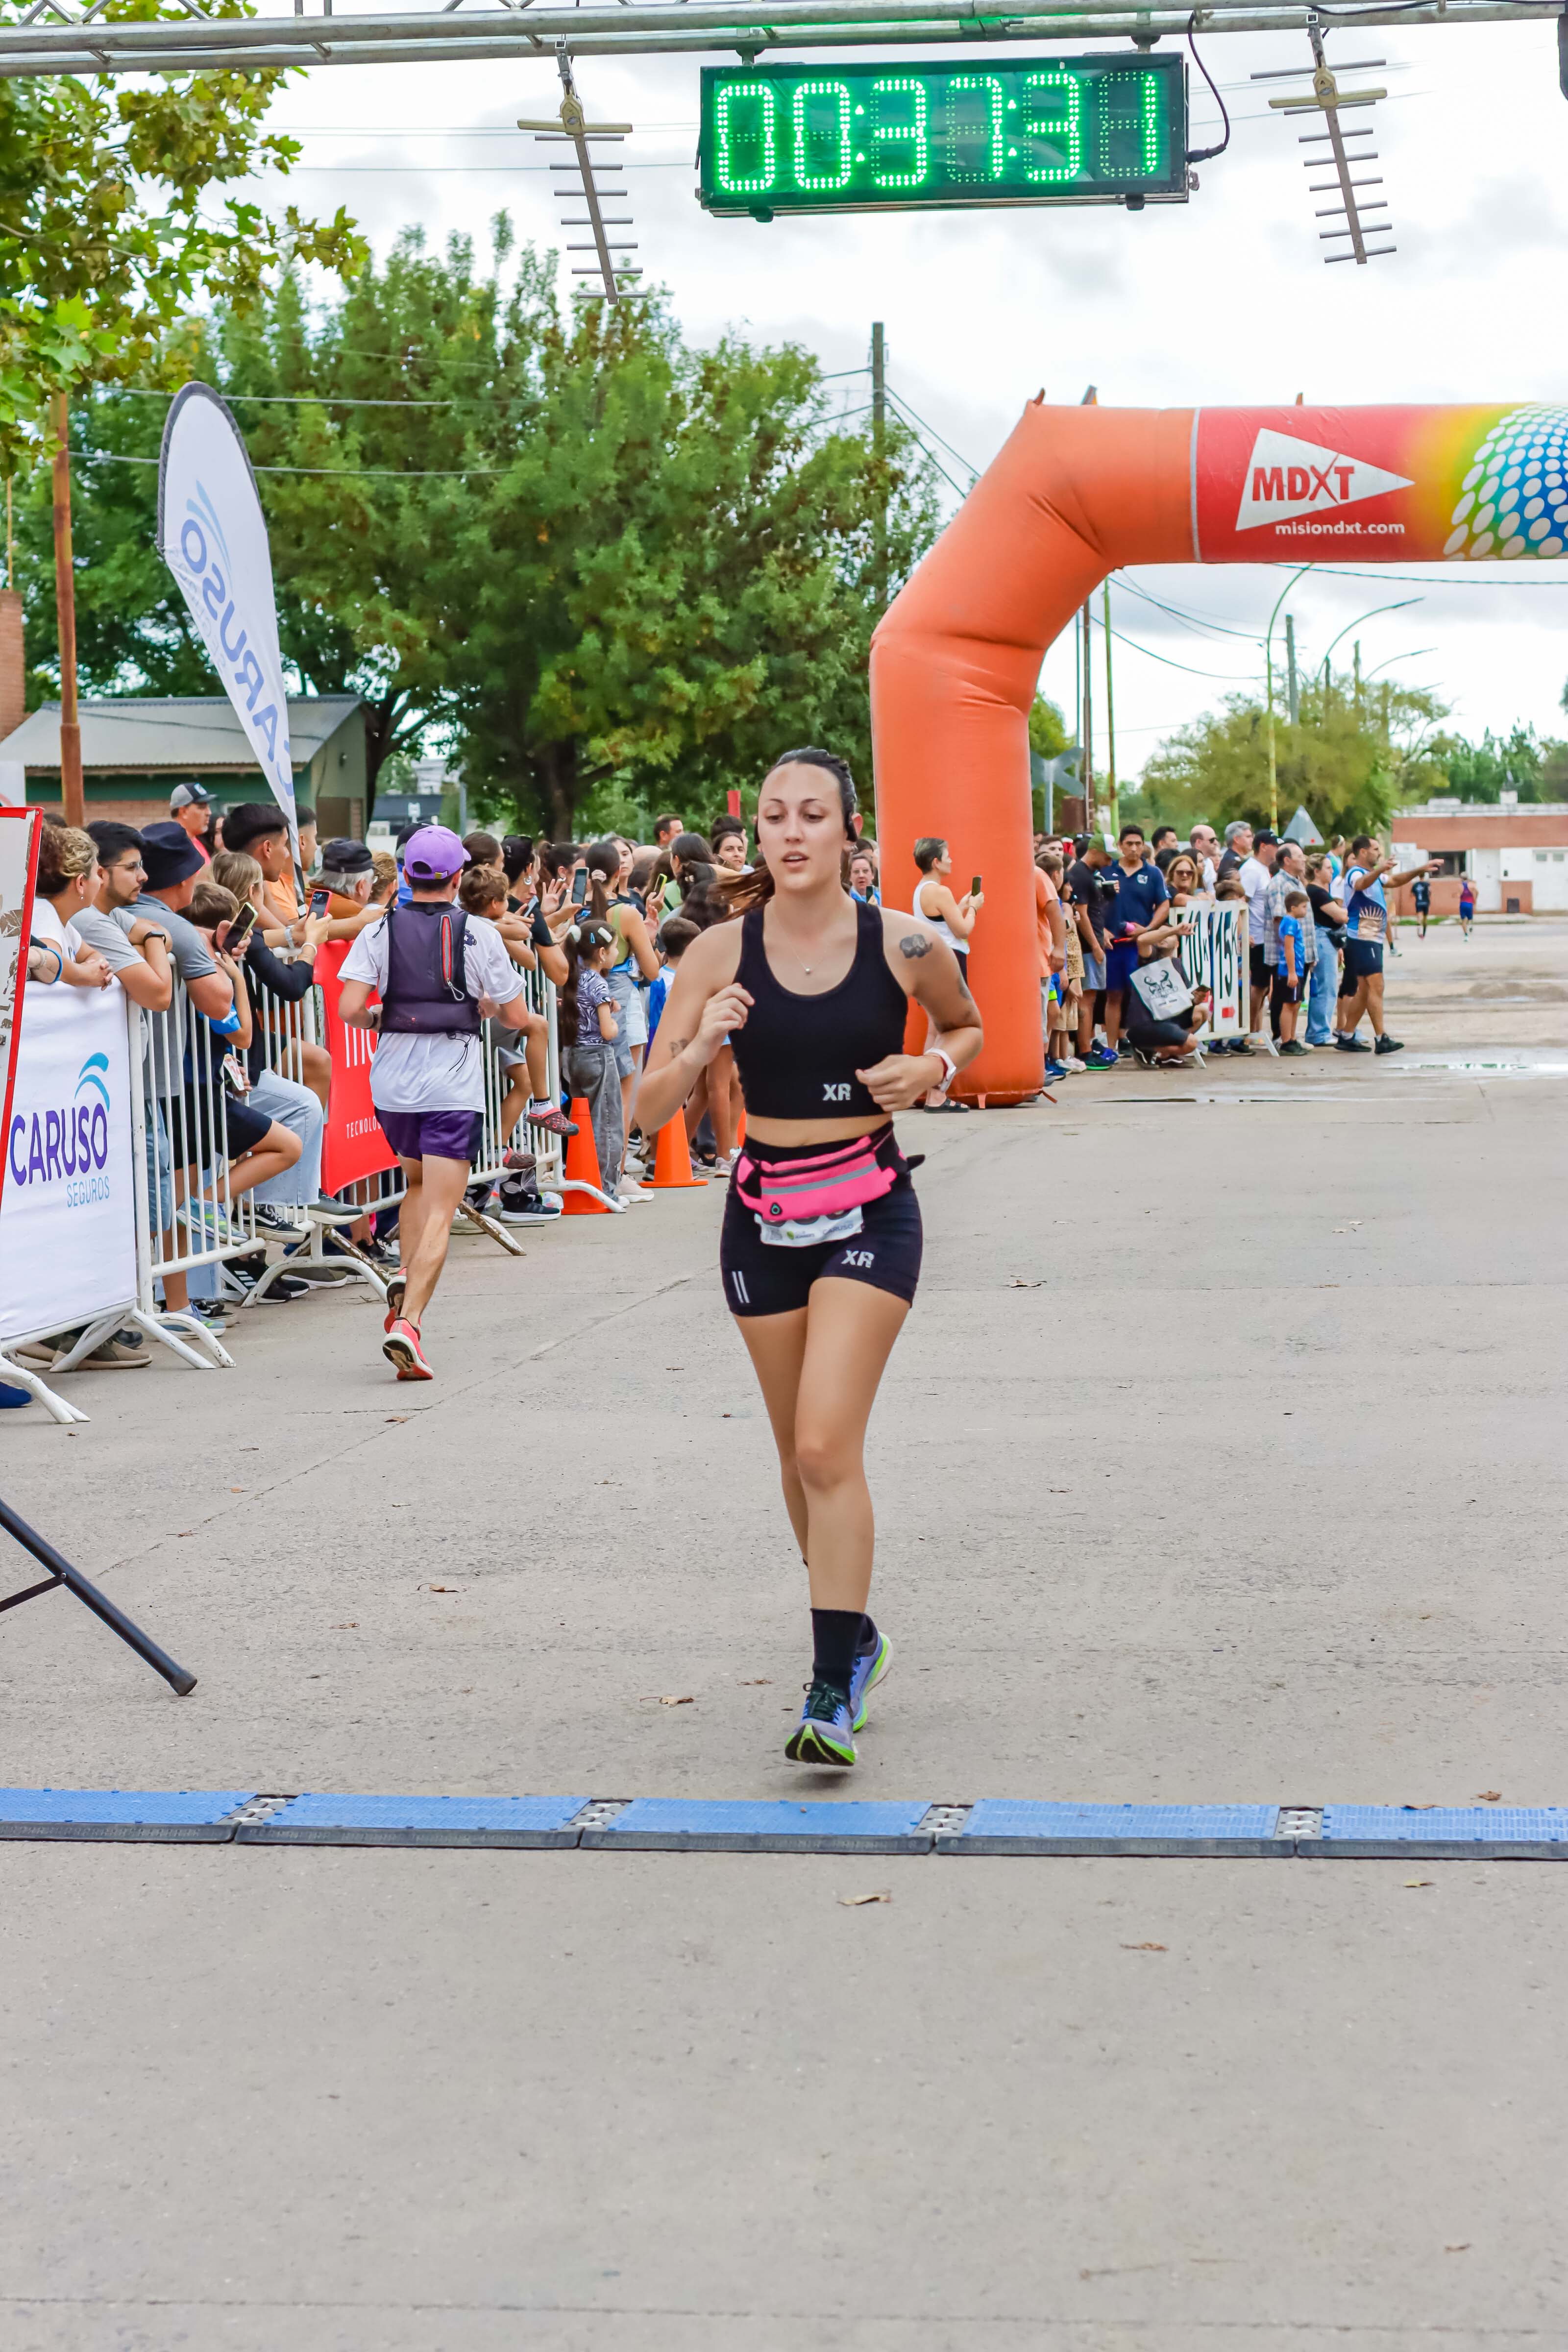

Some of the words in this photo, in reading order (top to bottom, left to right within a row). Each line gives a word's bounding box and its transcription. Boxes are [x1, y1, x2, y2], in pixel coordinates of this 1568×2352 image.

[717, 73, 1157, 192] 00:37:31
[1252, 453, 1355, 504] MDXT
[1275, 520, 1405, 535] misiondxt.com
[823, 1083, 851, 1101] XR
[10, 1103, 107, 1186] CARUSO
[67, 1176, 109, 1207] SEGUROS
[841, 1250, 875, 1268] XR
